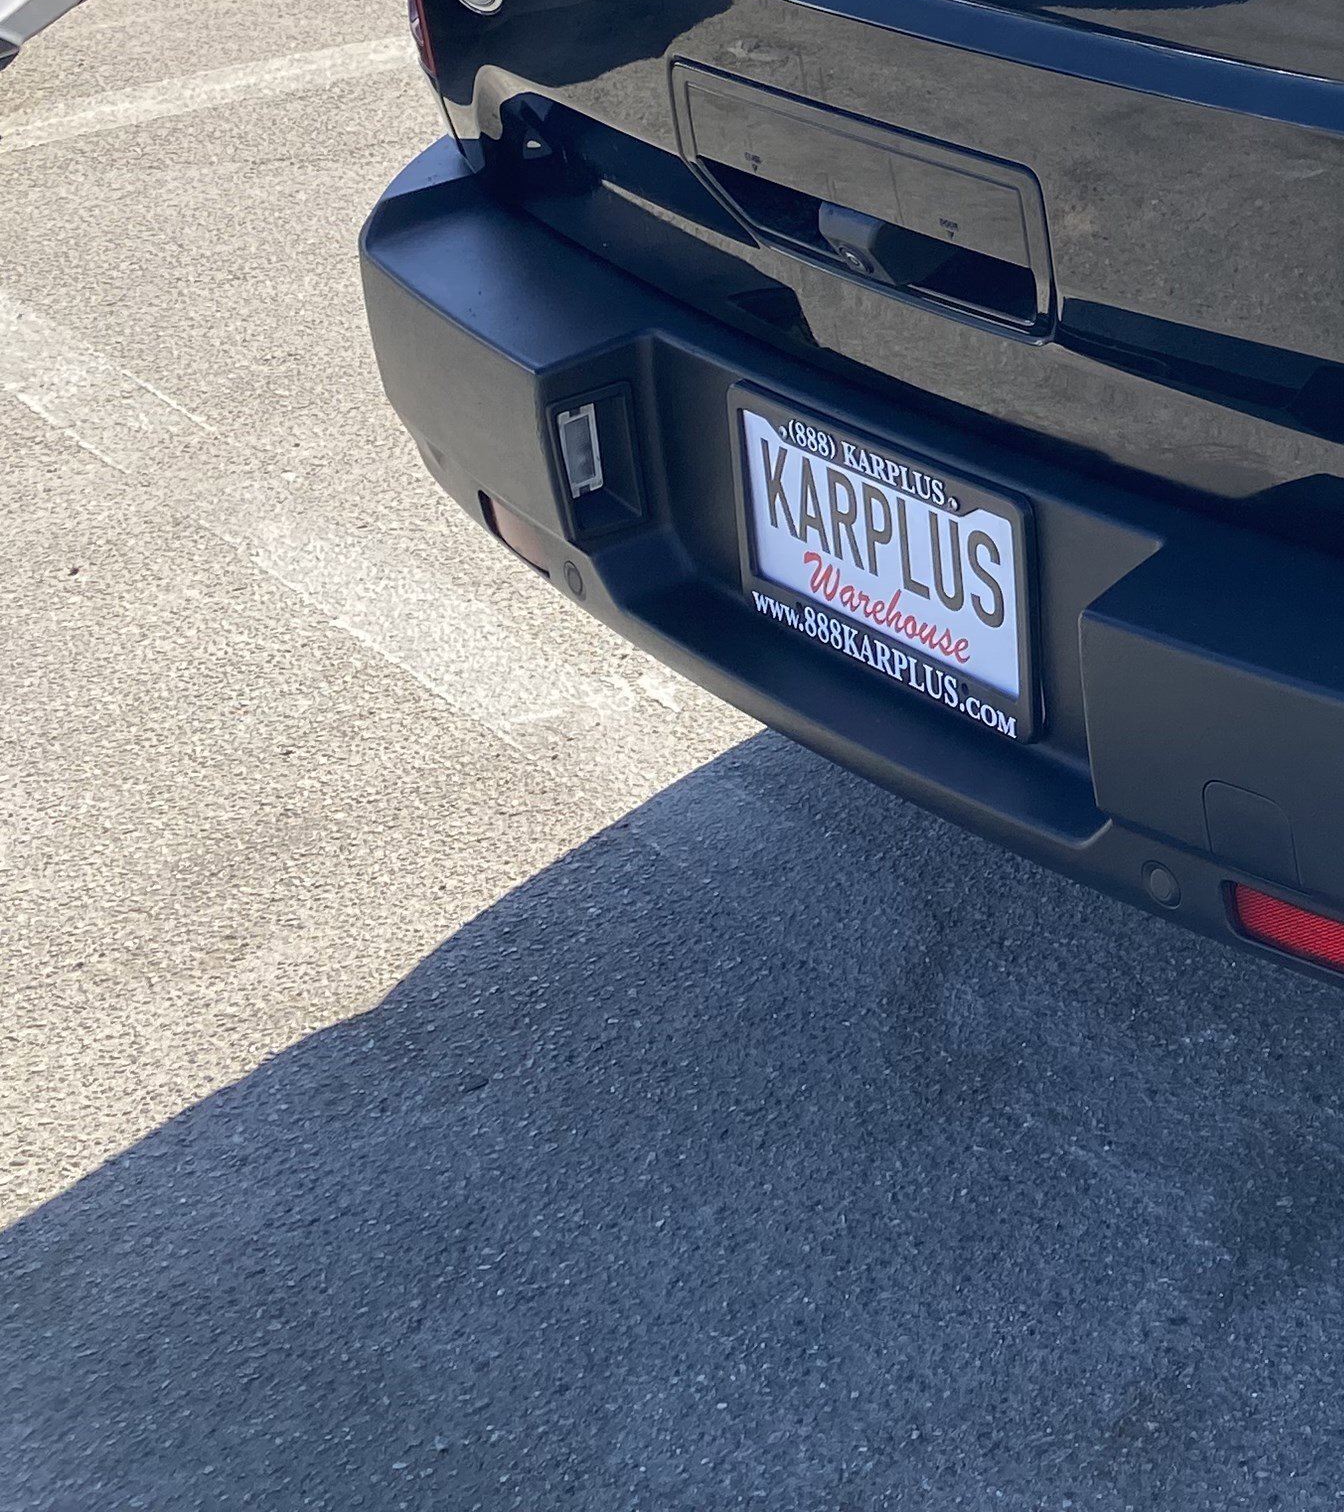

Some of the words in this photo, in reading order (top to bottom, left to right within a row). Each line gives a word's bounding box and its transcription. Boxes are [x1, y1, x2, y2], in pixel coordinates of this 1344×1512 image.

[788, 419, 836, 459] (888)
[841, 440, 945, 506] KARPLUS
[760, 437, 1004, 628] KARPLUS
[803, 550, 971, 663] Warehouse
